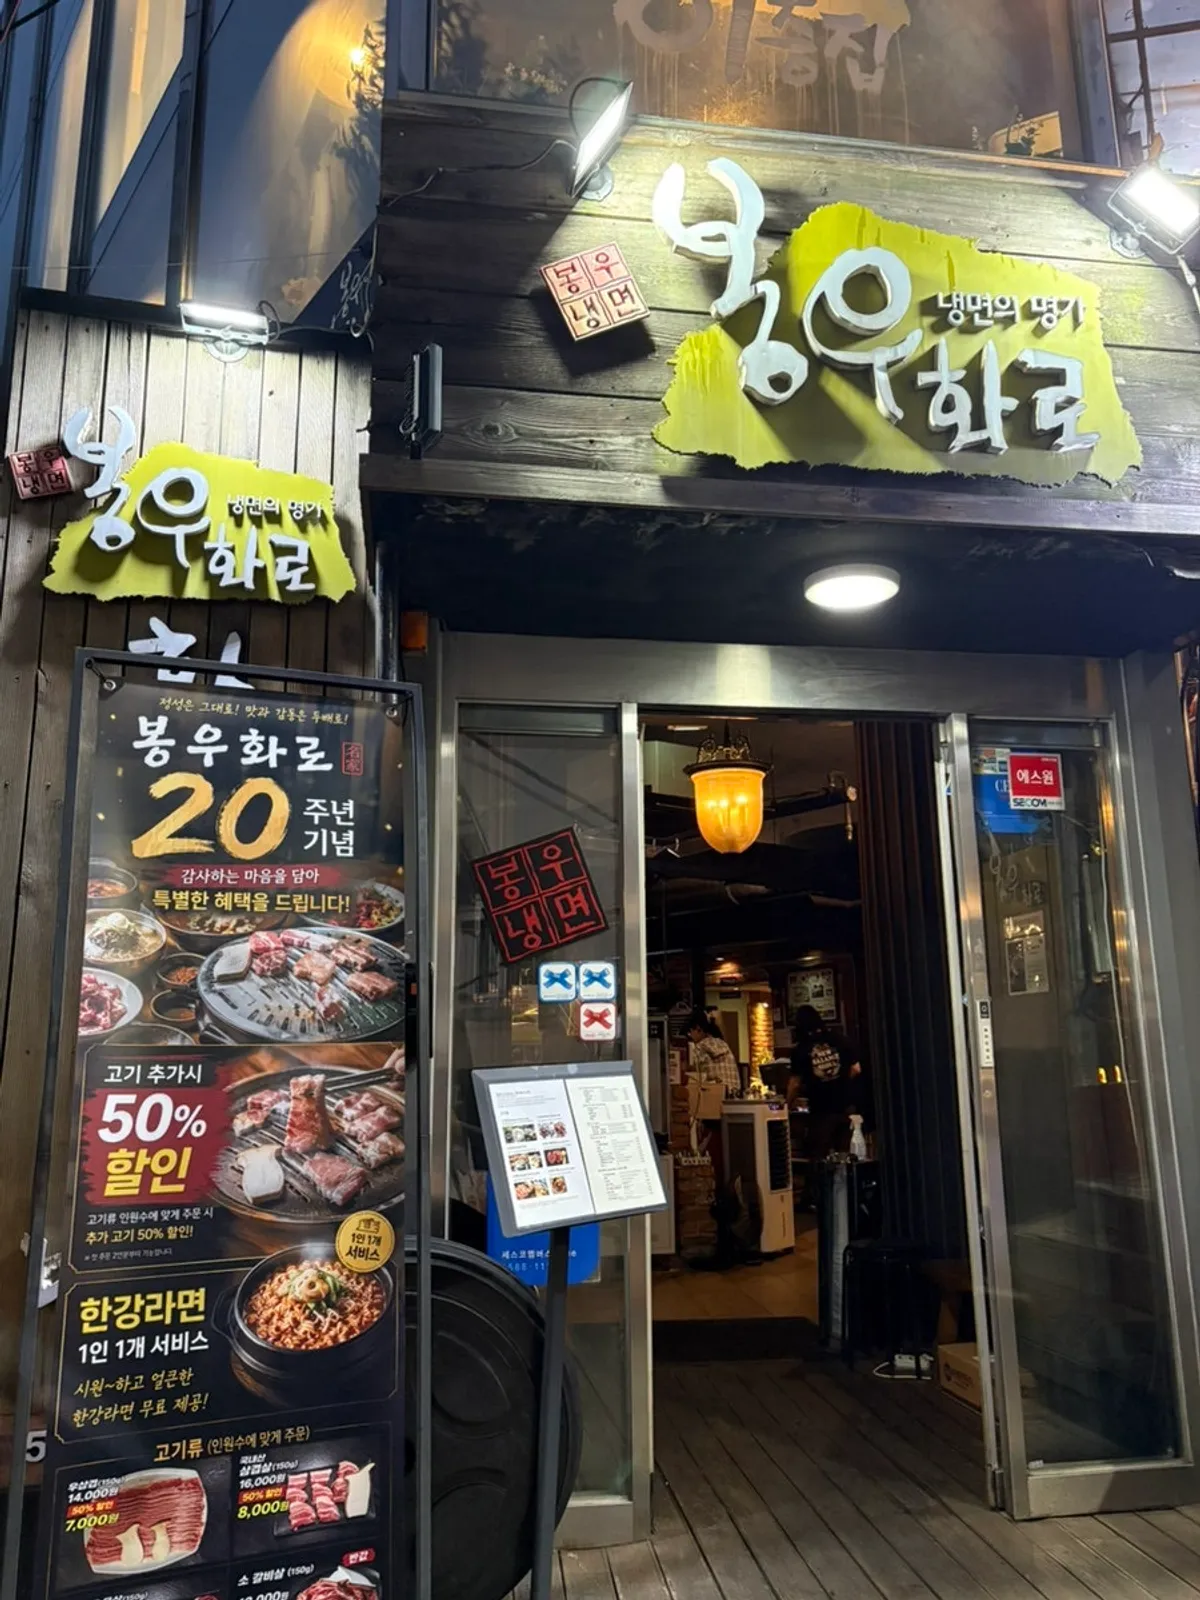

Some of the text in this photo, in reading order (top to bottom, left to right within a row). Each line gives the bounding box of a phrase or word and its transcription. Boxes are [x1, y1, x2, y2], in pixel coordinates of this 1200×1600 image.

[568, 283, 642, 329] 냉면
[937, 291, 1086, 330] 냉면의 명가
[227, 494, 323, 520] 냉면의 명가
[159, 697, 350, 726] 정성은 그대로! 맛과 감동은 두배로!
[1016, 769, 1054, 786] 에스원
[131, 771, 291, 860] 20
[303, 798, 355, 827] 주년
[303, 828, 355, 857] 기념
[181, 868, 320, 885] 감사하는 마음을 담아
[487, 845, 574, 901] 봉우
[152, 890, 350, 914] 특별한 혜택을 드립니다!
[504, 886, 598, 950] 냉면
[104, 1063, 202, 1084] 고기 추가시
[98, 1093, 207, 1143] 50%
[104, 1147, 193, 1197] 할인
[87, 1213, 117, 1225] 고기류
[119, 1210, 158, 1224] 인원수에
[182, 1207, 201, 1220] 주문
[203, 1207, 214, 1219] 시
[86, 1225, 193, 1245] 추가 고기 50% 할인!
[345, 1246, 380, 1261] 서비스
[80, 1288, 206, 1334] 한강라면
[79, 1331, 209, 1364] 1인 1개 서비스
[73, 1367, 194, 1399] 시원~하고 얼큰한
[72, 1393, 209, 1428] 한강라면 무료 제공!
[153, 1438, 204, 1462] 고기류
[207, 1435, 257, 1455] (인원수에
[259, 1431, 283, 1448] 맞게
[237, 1564, 315, 1586] 소 갈비살 (150g)
